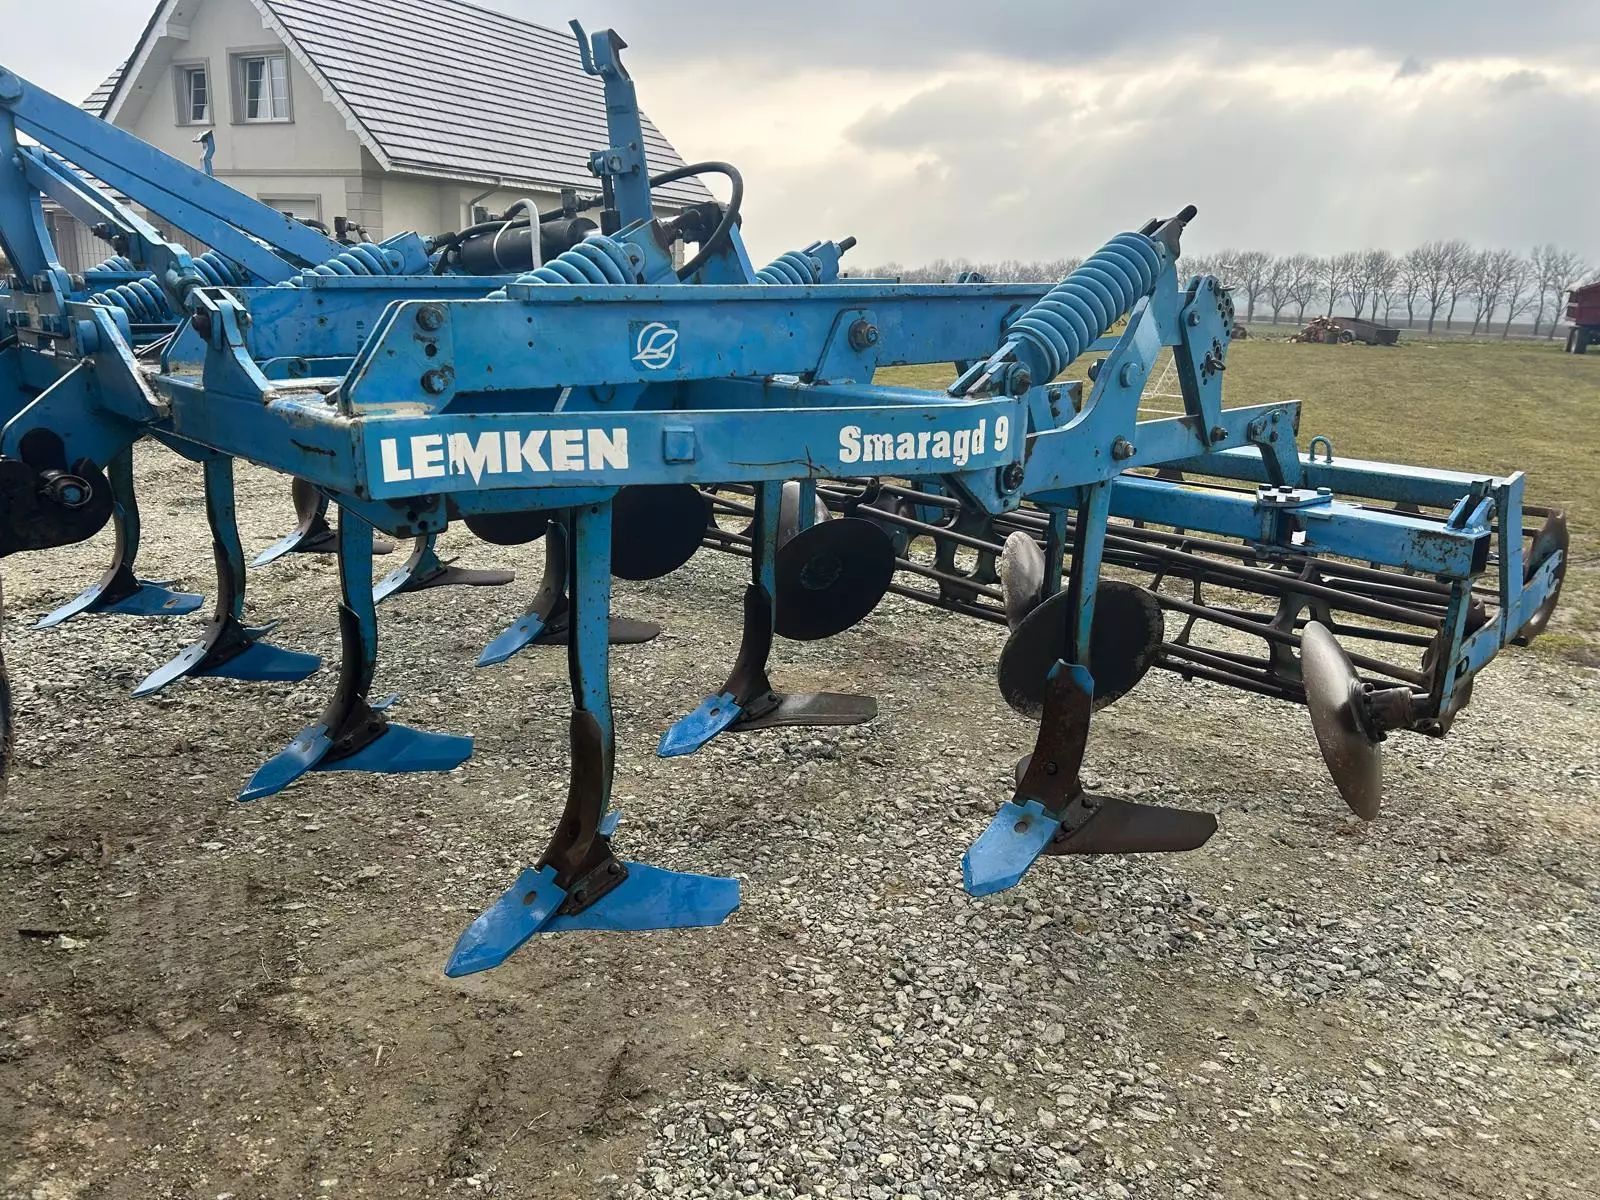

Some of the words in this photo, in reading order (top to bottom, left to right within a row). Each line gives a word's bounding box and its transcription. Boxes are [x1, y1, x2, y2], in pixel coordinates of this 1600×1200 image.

[380, 428, 629, 486] LEMKEN
[839, 419, 986, 466] Smaragd
[994, 415, 1009, 452] 9
